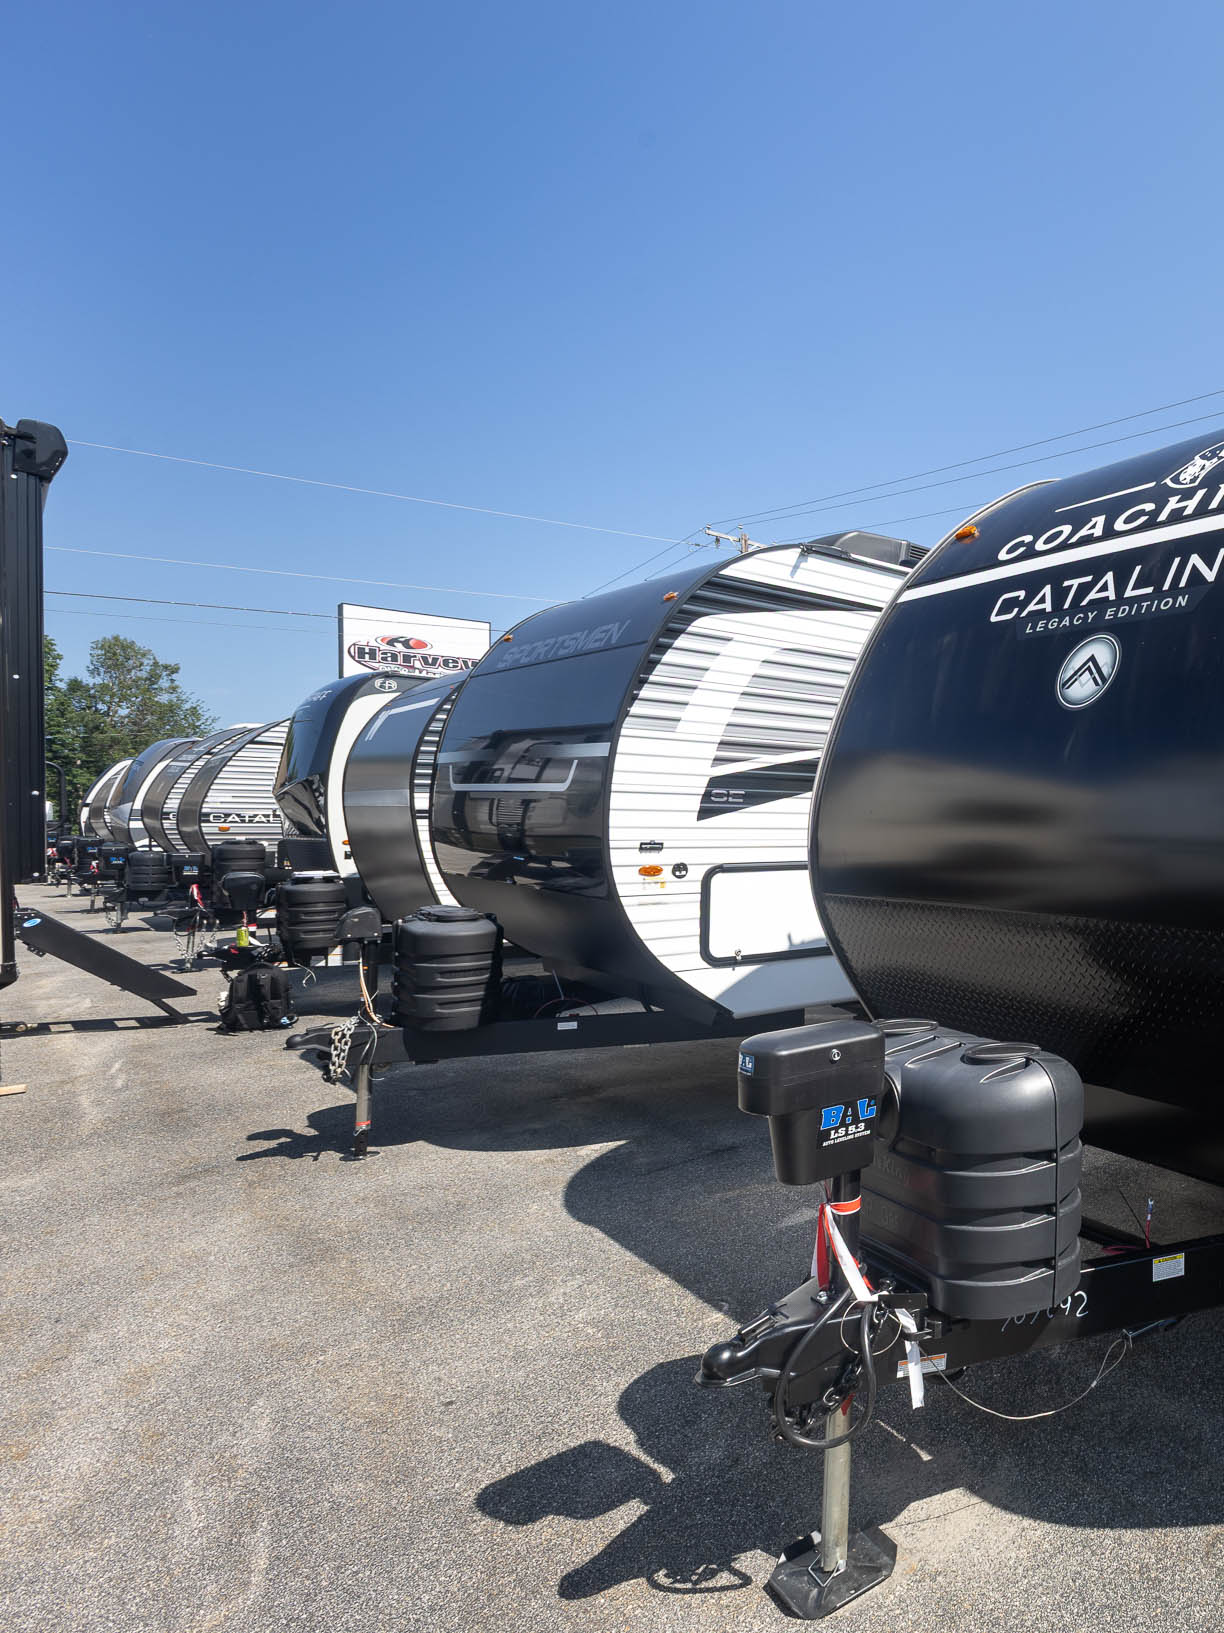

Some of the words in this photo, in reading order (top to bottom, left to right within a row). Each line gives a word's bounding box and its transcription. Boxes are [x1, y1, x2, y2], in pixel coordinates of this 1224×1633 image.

[1025, 609, 1098, 635] LEGACY
[1104, 594, 1190, 621] EDITION
[830, 1127, 846, 1139] LS
[847, 1122, 865, 1134] 5.3
